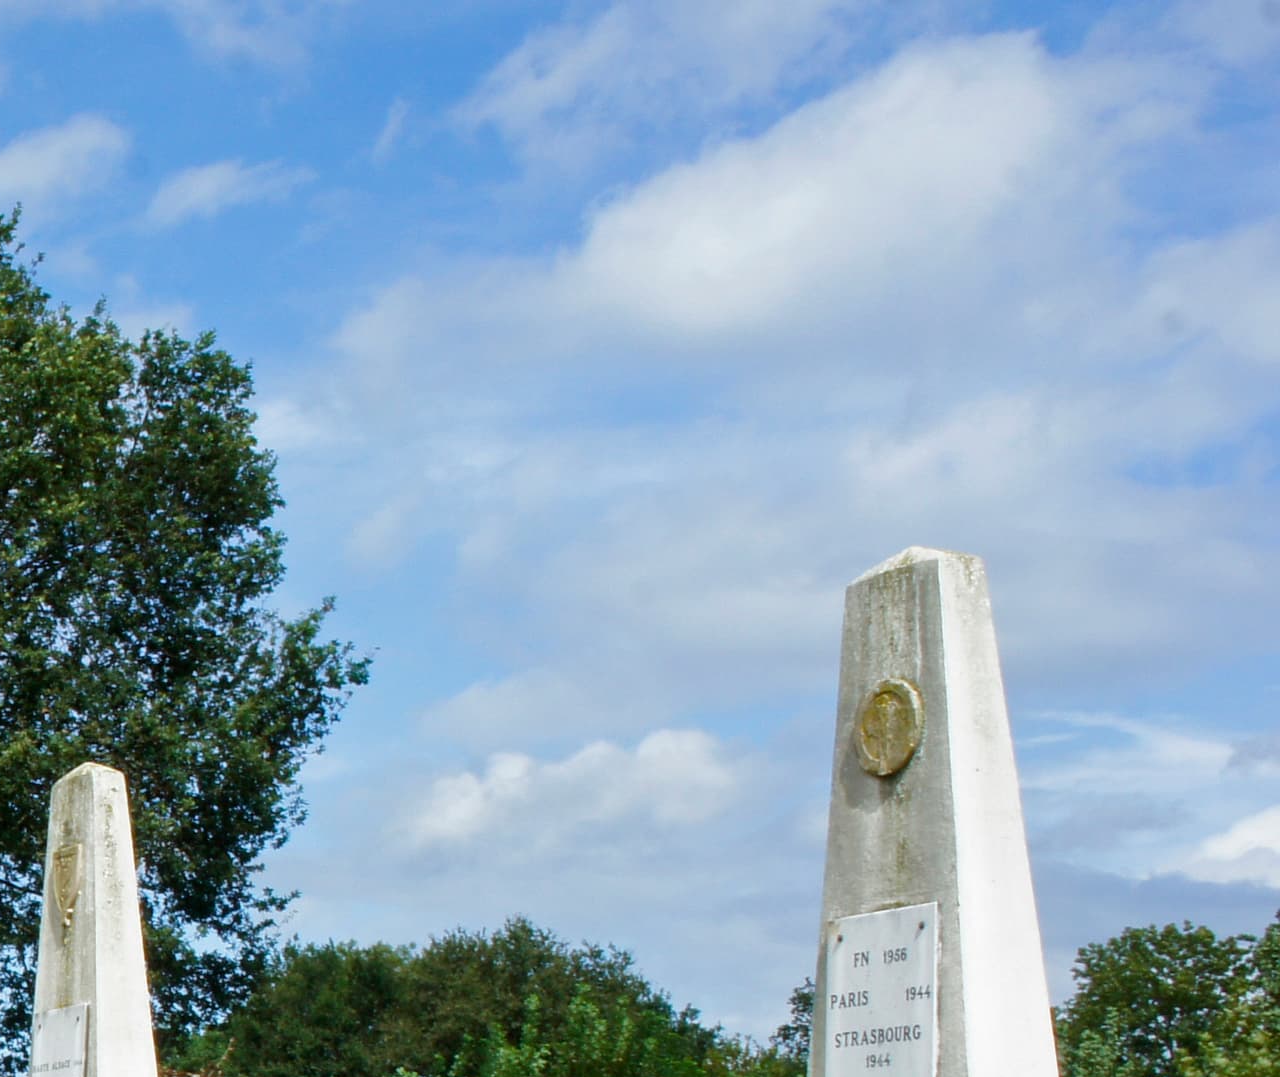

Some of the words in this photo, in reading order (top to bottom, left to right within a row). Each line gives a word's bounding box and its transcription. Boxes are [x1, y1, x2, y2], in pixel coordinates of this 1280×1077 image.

[853, 951, 869, 968] FN
[830, 990, 869, 1009] PARIS
[905, 985, 931, 1001] 1944
[835, 1024, 921, 1048] STRASBOURG
[866, 1053, 890, 1068] 1944
